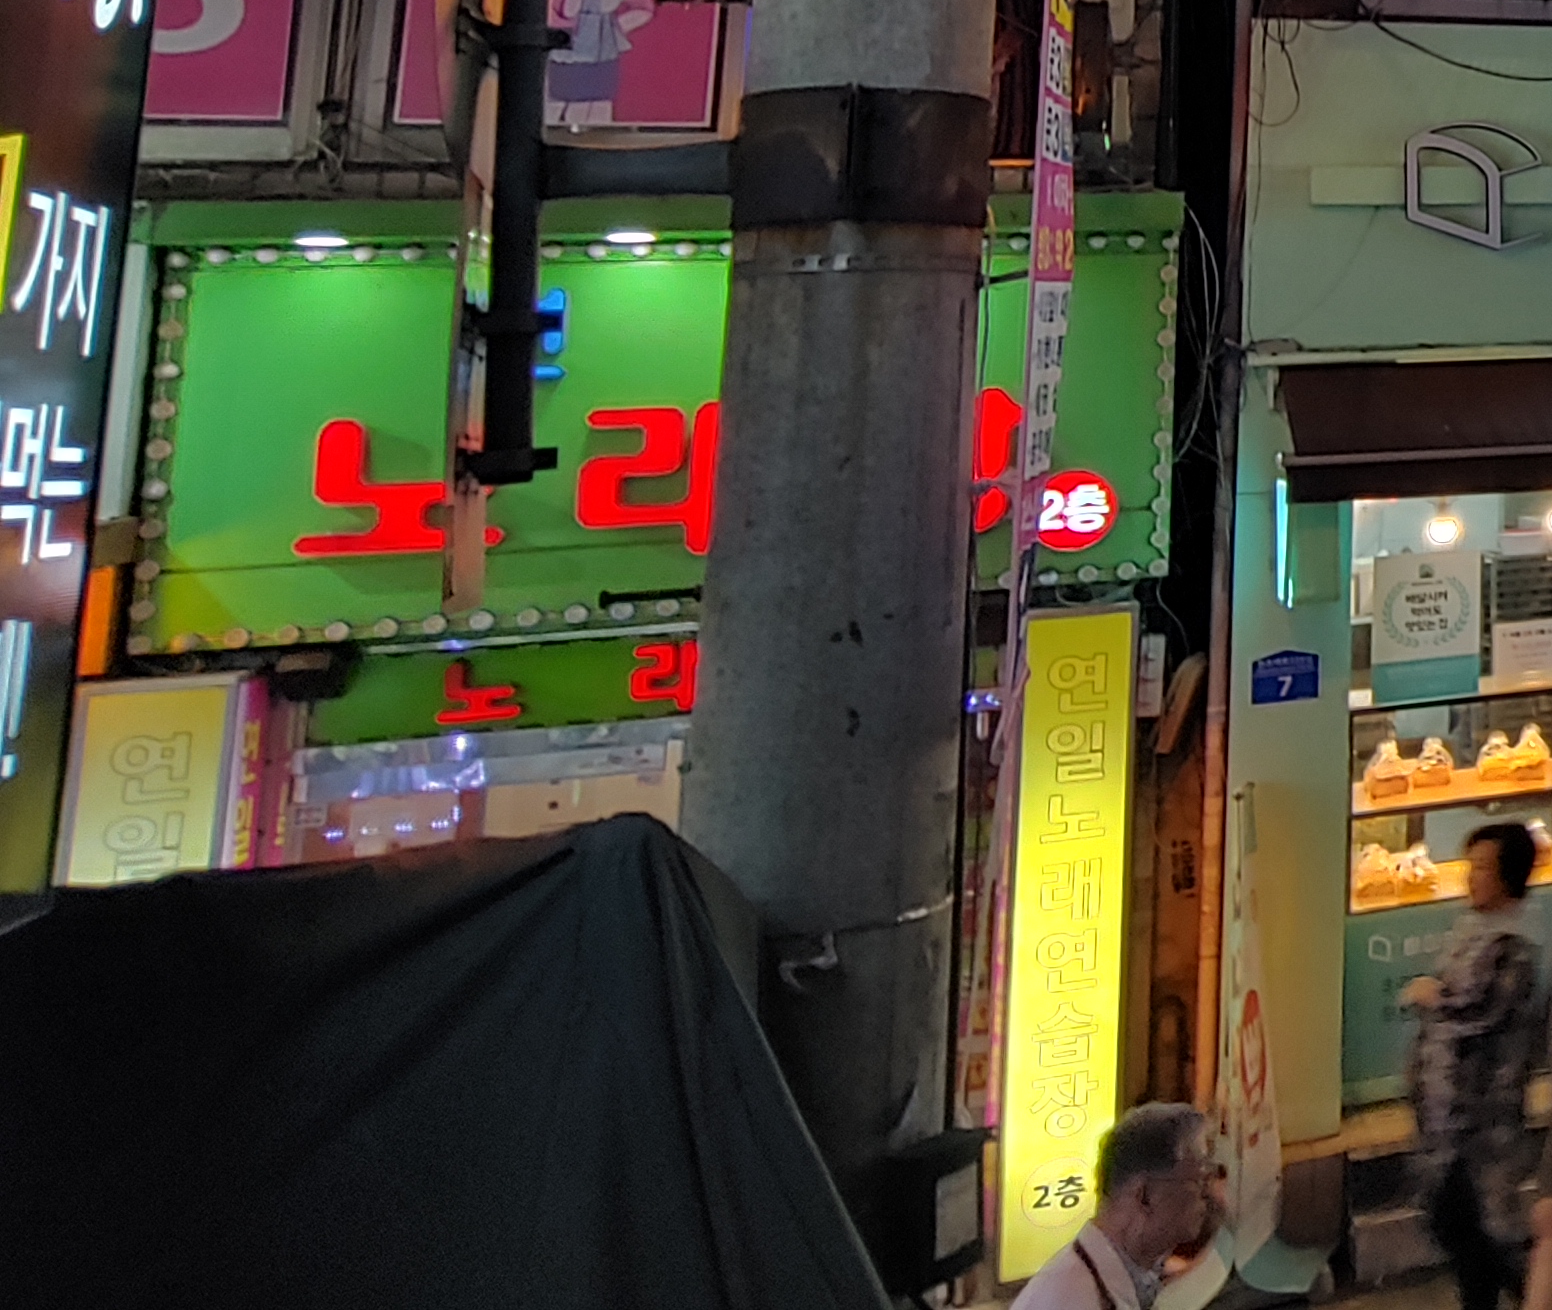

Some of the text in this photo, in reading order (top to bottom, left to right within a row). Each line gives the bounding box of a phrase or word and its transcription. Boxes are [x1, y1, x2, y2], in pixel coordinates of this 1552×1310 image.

[11, 190, 110, 358] 가지
[1038, 483, 1109, 533] 2층
[1277, 675, 1293, 698] 7
[1029, 651, 1110, 1141] 연일노래연습장
[1031, 1172, 1088, 1211] 2층
